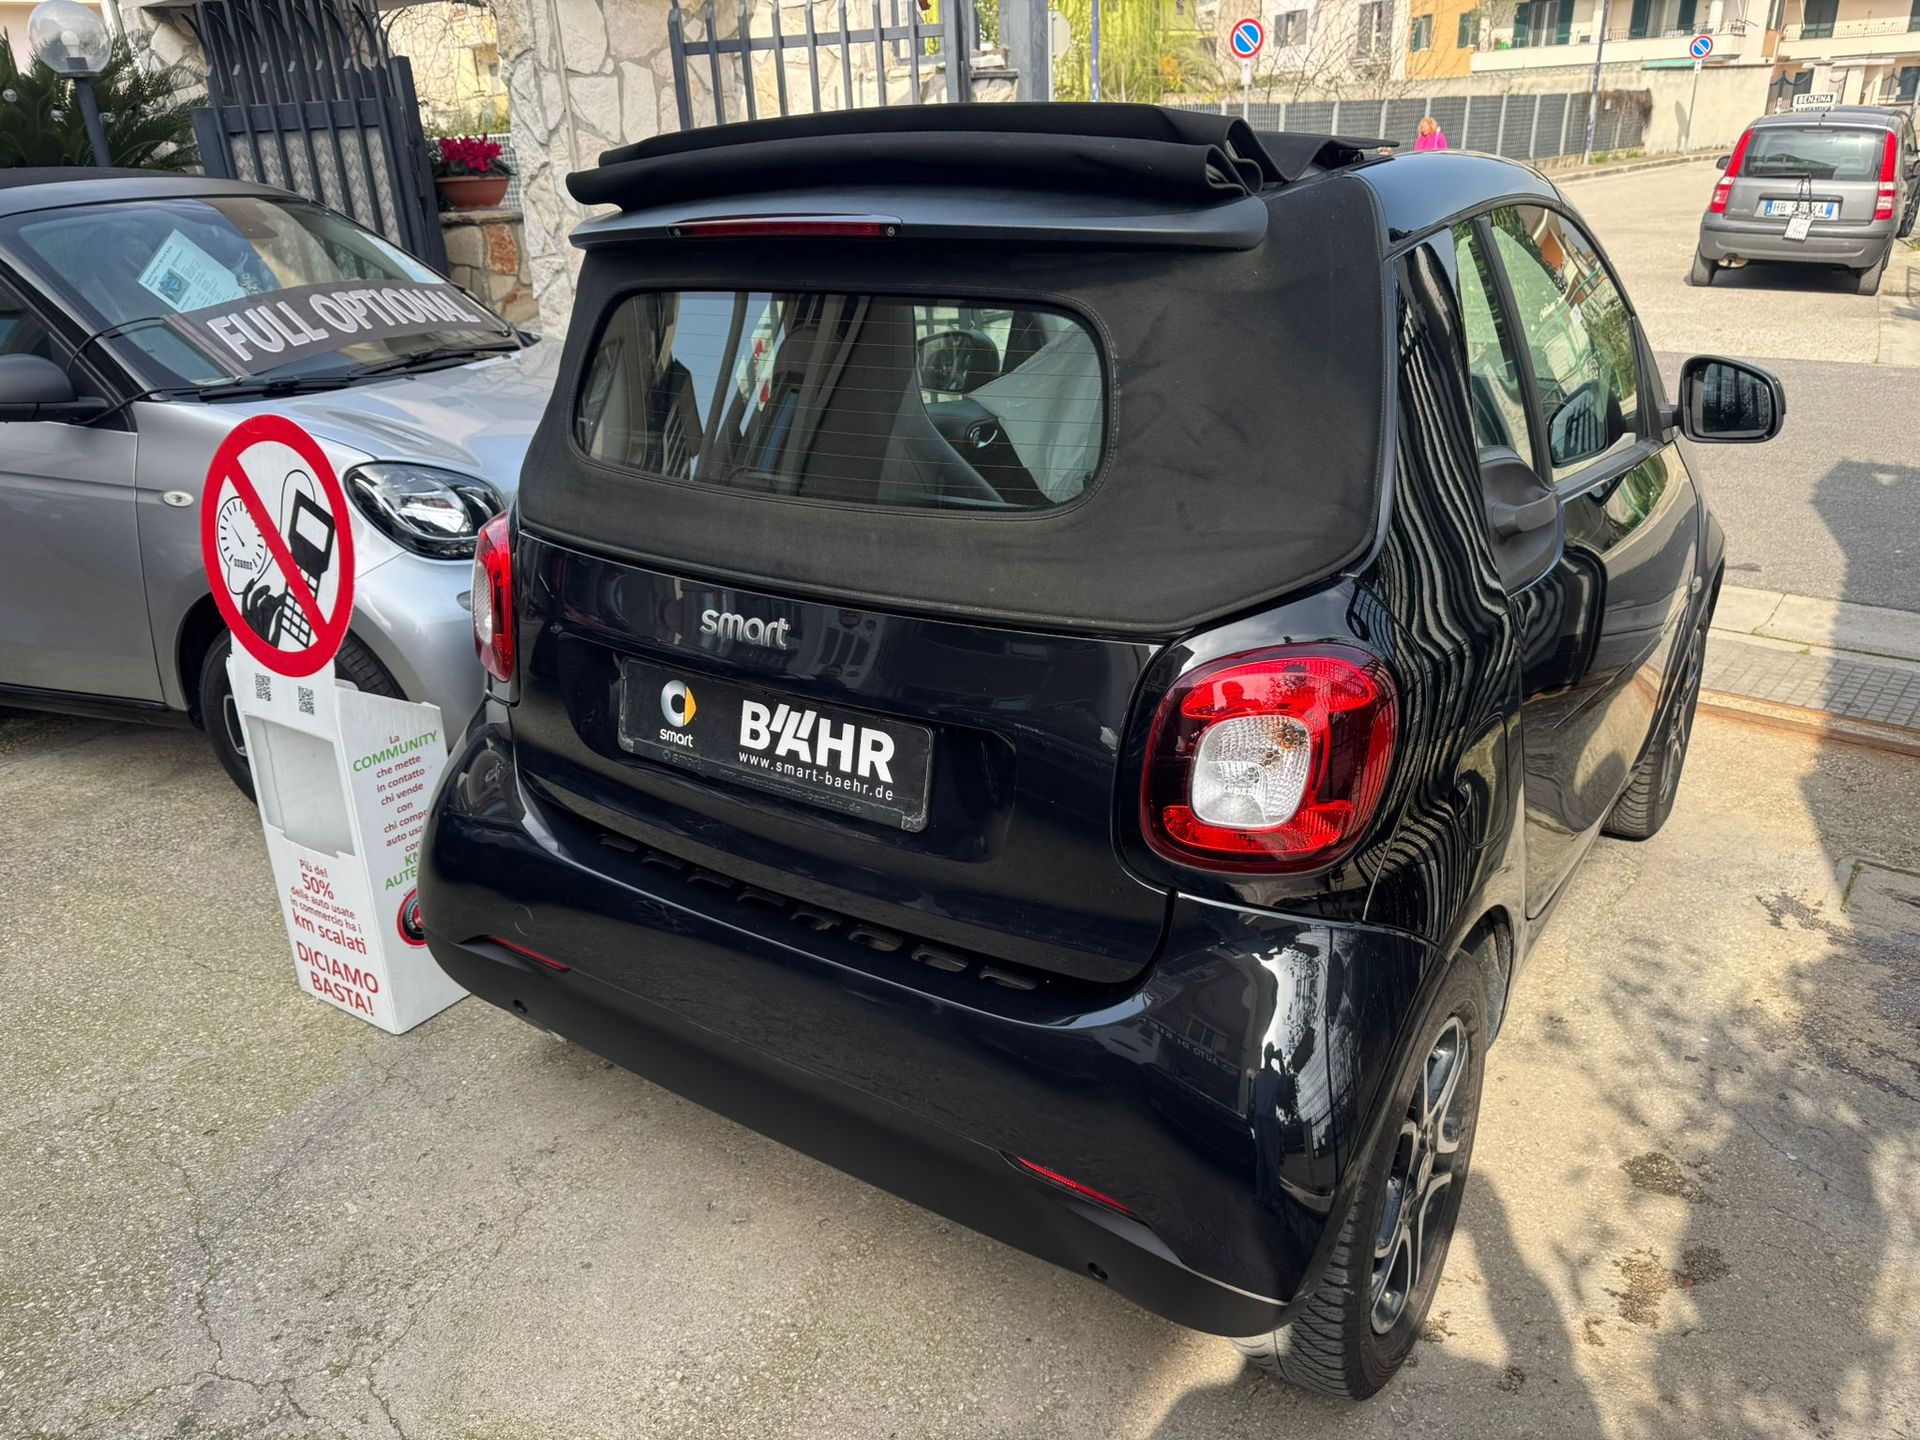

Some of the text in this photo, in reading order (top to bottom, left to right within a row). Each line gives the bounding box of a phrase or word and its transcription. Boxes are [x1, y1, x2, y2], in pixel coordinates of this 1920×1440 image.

[206, 287, 481, 362] FULL OPTIONAL
[700, 608, 791, 650] smart
[352, 730, 437, 772] COMMUNITY
[388, 735, 400, 744] La
[659, 728, 694, 748] smart
[376, 755, 421, 778] che mette
[376, 768, 425, 793] in contatto
[738, 751, 894, 801] www.smart-baehr.de
[381, 783, 424, 806] chi vende
[396, 801, 413, 813] con
[384, 809, 429, 833] chi compr
[386, 833, 407, 847] auto
[314, 865, 328, 878] del
[301, 872, 335, 900] 50%
[290, 885, 356, 920] delle auto usate
[292, 907, 367, 955] km scalati
[299, 902, 344, 927] commercio
[345, 918, 357, 932] ha
[296, 940, 379, 994] DICIAMO
[310, 970, 374, 1017] BASTA!
